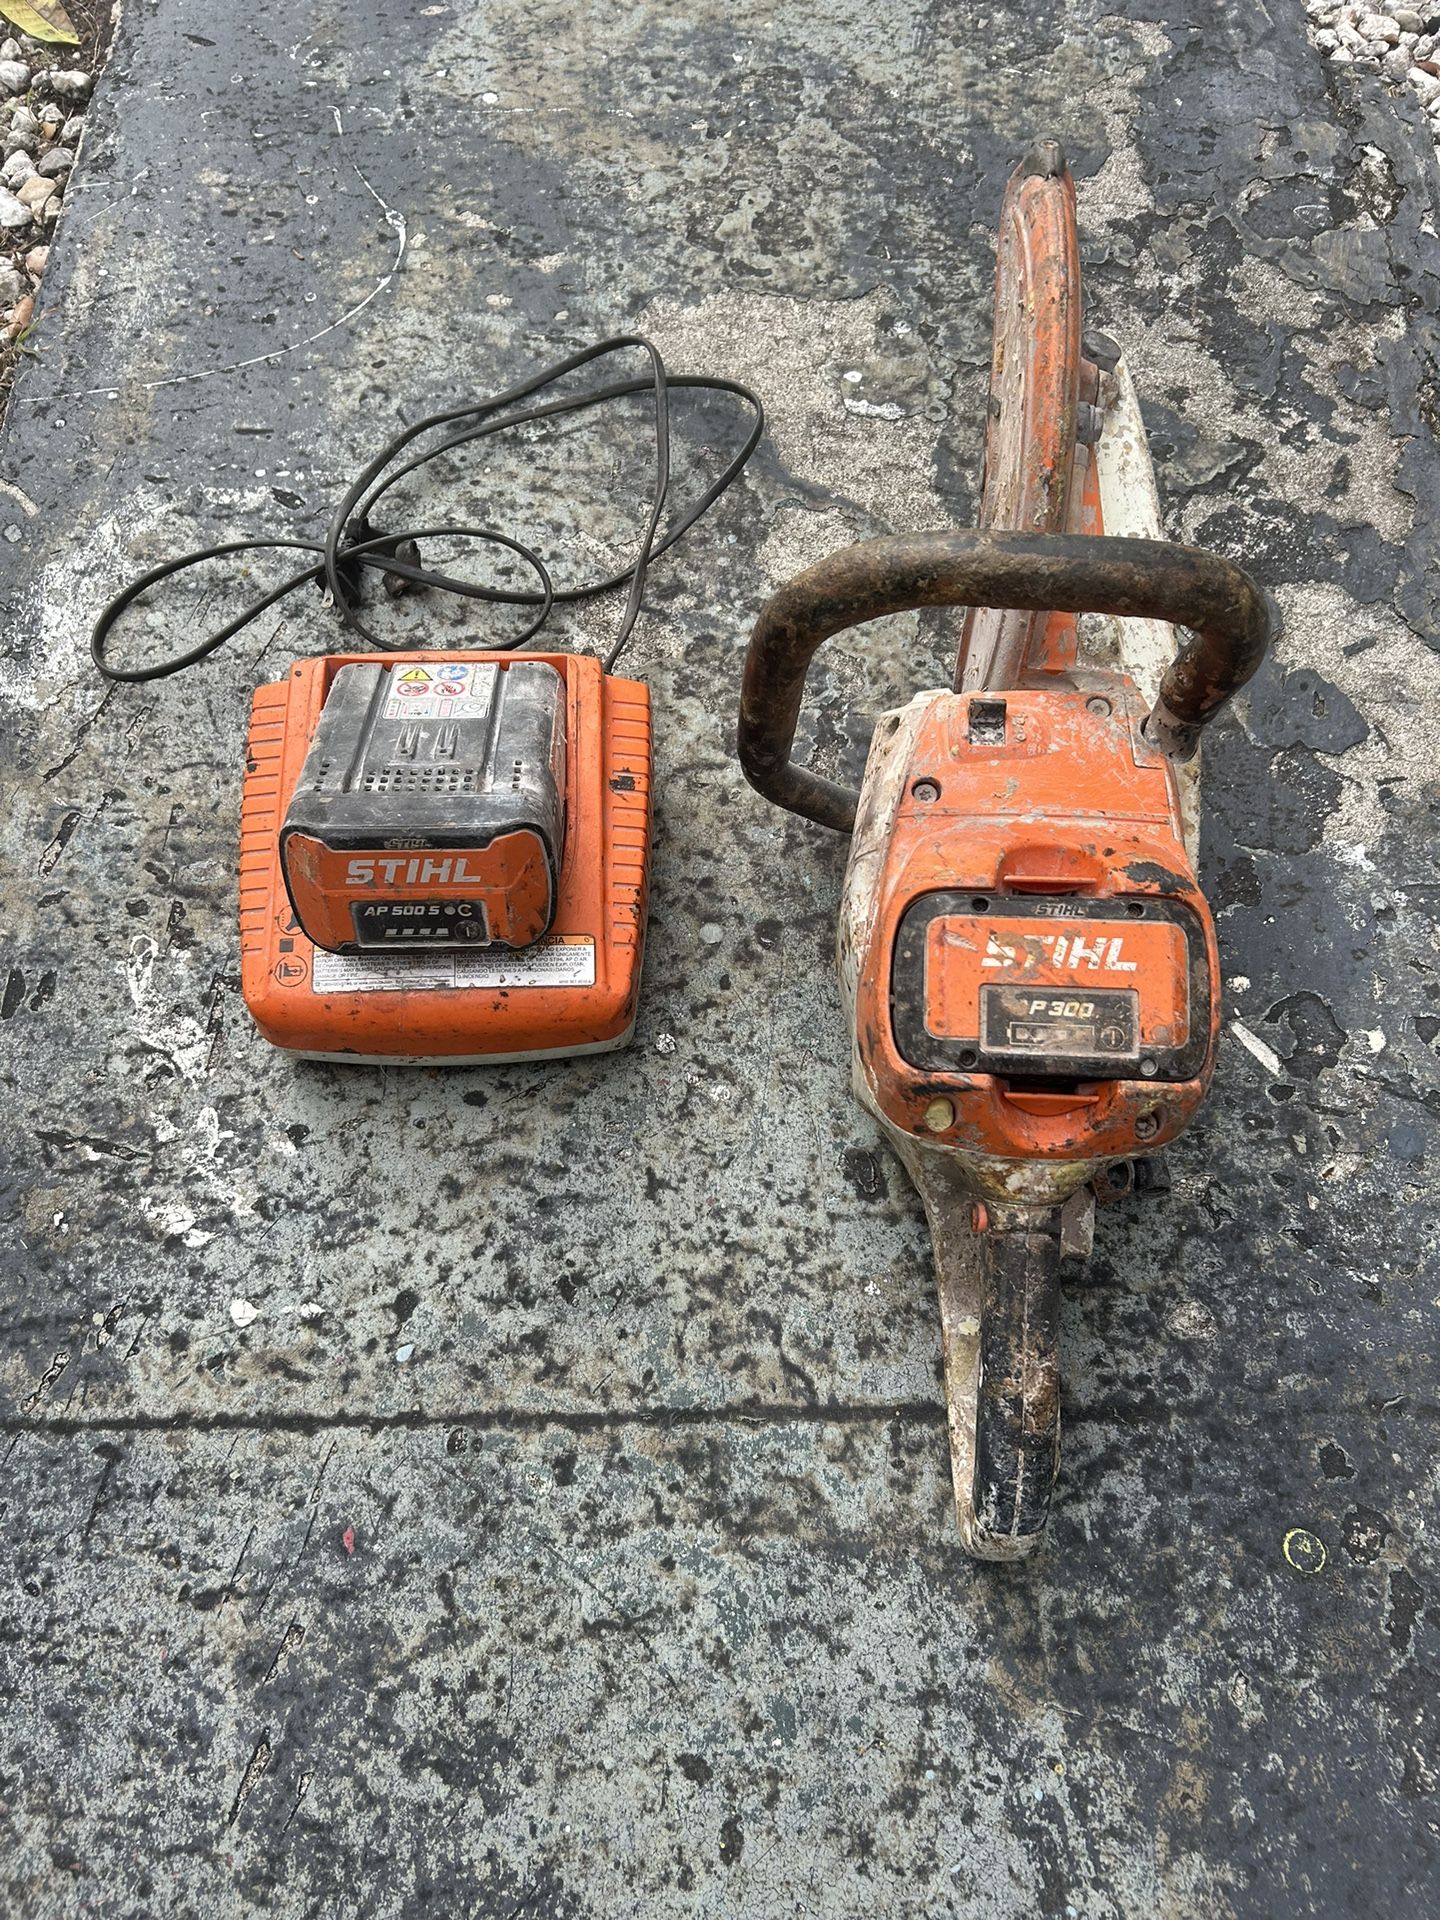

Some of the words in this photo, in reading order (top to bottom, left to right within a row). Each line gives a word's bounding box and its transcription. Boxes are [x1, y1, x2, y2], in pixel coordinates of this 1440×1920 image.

[345, 858, 481, 884] STIHL
[364, 906, 389, 916] AP
[392, 905, 425, 915] 500
[1036, 904, 1084, 916] STIHL
[981, 935, 1138, 971] STIHL
[1048, 1001, 1095, 1018] 300
